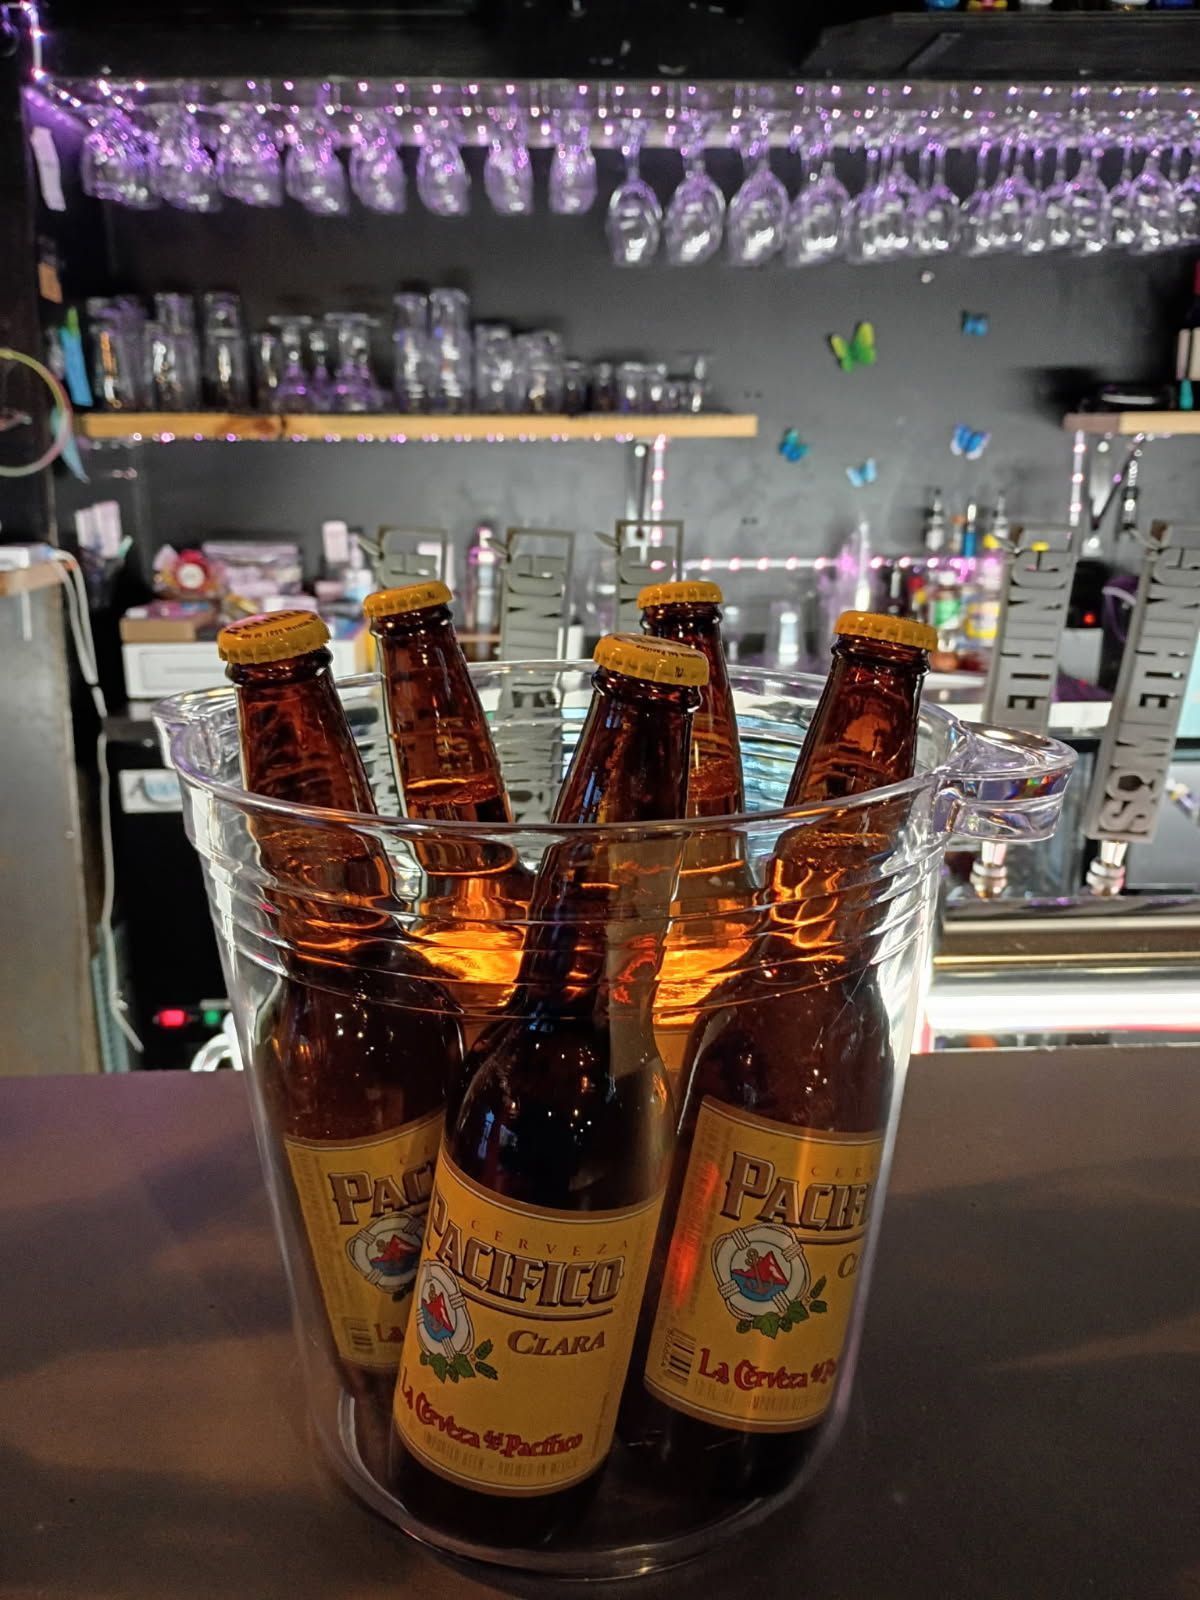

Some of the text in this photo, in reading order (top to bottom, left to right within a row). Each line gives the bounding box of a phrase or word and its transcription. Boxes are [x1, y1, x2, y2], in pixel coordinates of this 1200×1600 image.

[1098, 546, 1200, 834] SOMETHING
[719, 1150, 869, 1232] PACIF
[426, 1188, 626, 1308] PACIFICO
[470, 1219, 628, 1257] CERVEZA
[507, 1329, 607, 1357] CLARA
[697, 1347, 730, 1385] La
[734, 1359, 808, 1391] Cerveza
[415, 1391, 481, 1449] Cerveza
